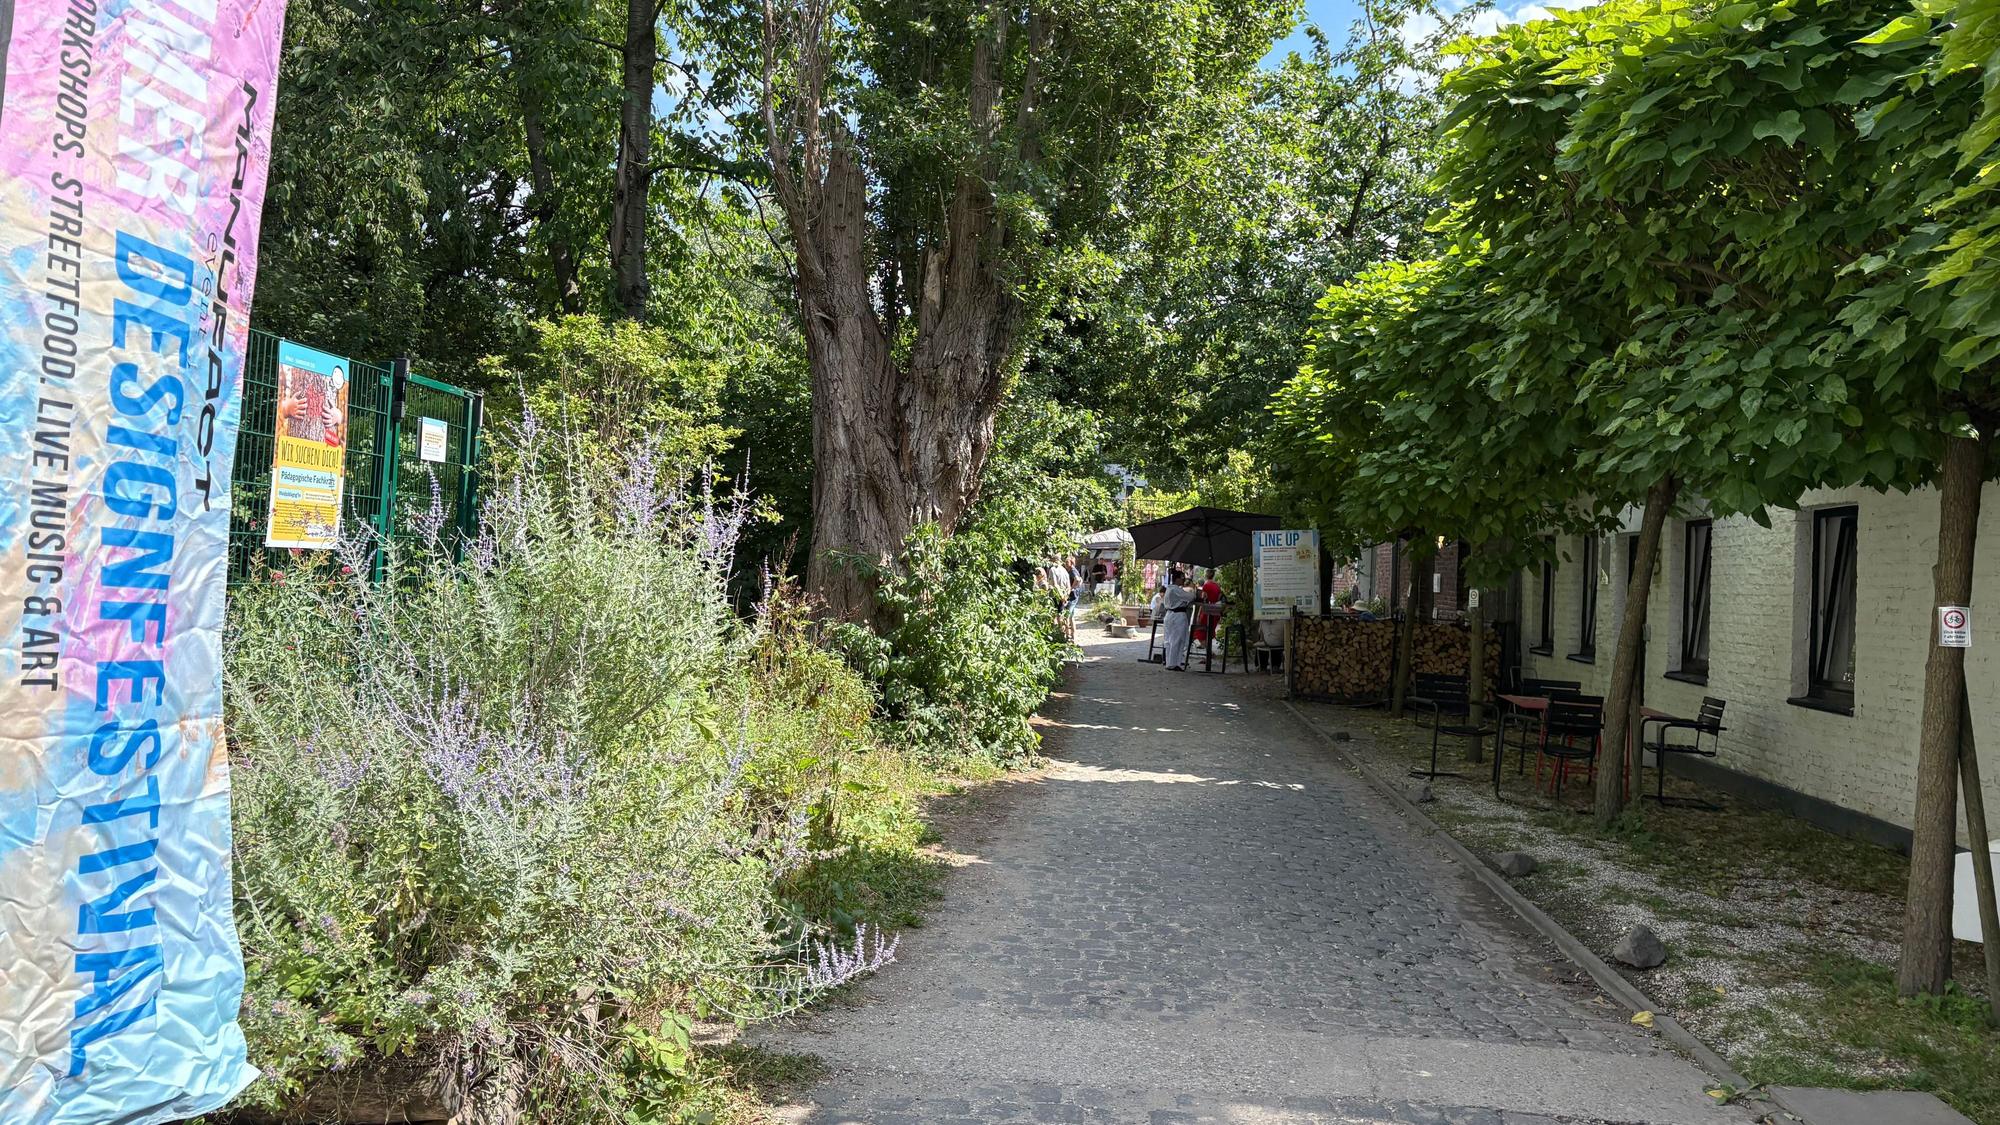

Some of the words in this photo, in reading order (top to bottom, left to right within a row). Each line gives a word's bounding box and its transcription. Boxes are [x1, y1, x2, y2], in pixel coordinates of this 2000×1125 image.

[115, 0, 217, 216] MER
[40, 171, 84, 384] STREETFOOD.
[196, 80, 258, 511] MANUFACT
[198, 231, 218, 334] event
[33, 397, 74, 472] LIVE
[281, 440, 294, 462] WIR
[295, 444, 321, 466] SUCHEN
[321, 449, 340, 469] DICH!
[280, 470, 313, 483] Pädagogische
[313, 475, 336, 486] Fachkraft
[27, 479, 68, 585] MUSIC
[1260, 532, 1283, 547] LINE
[1285, 532, 1300, 547] UP
[23, 595, 63, 616] &
[20, 625, 61, 692] ART
